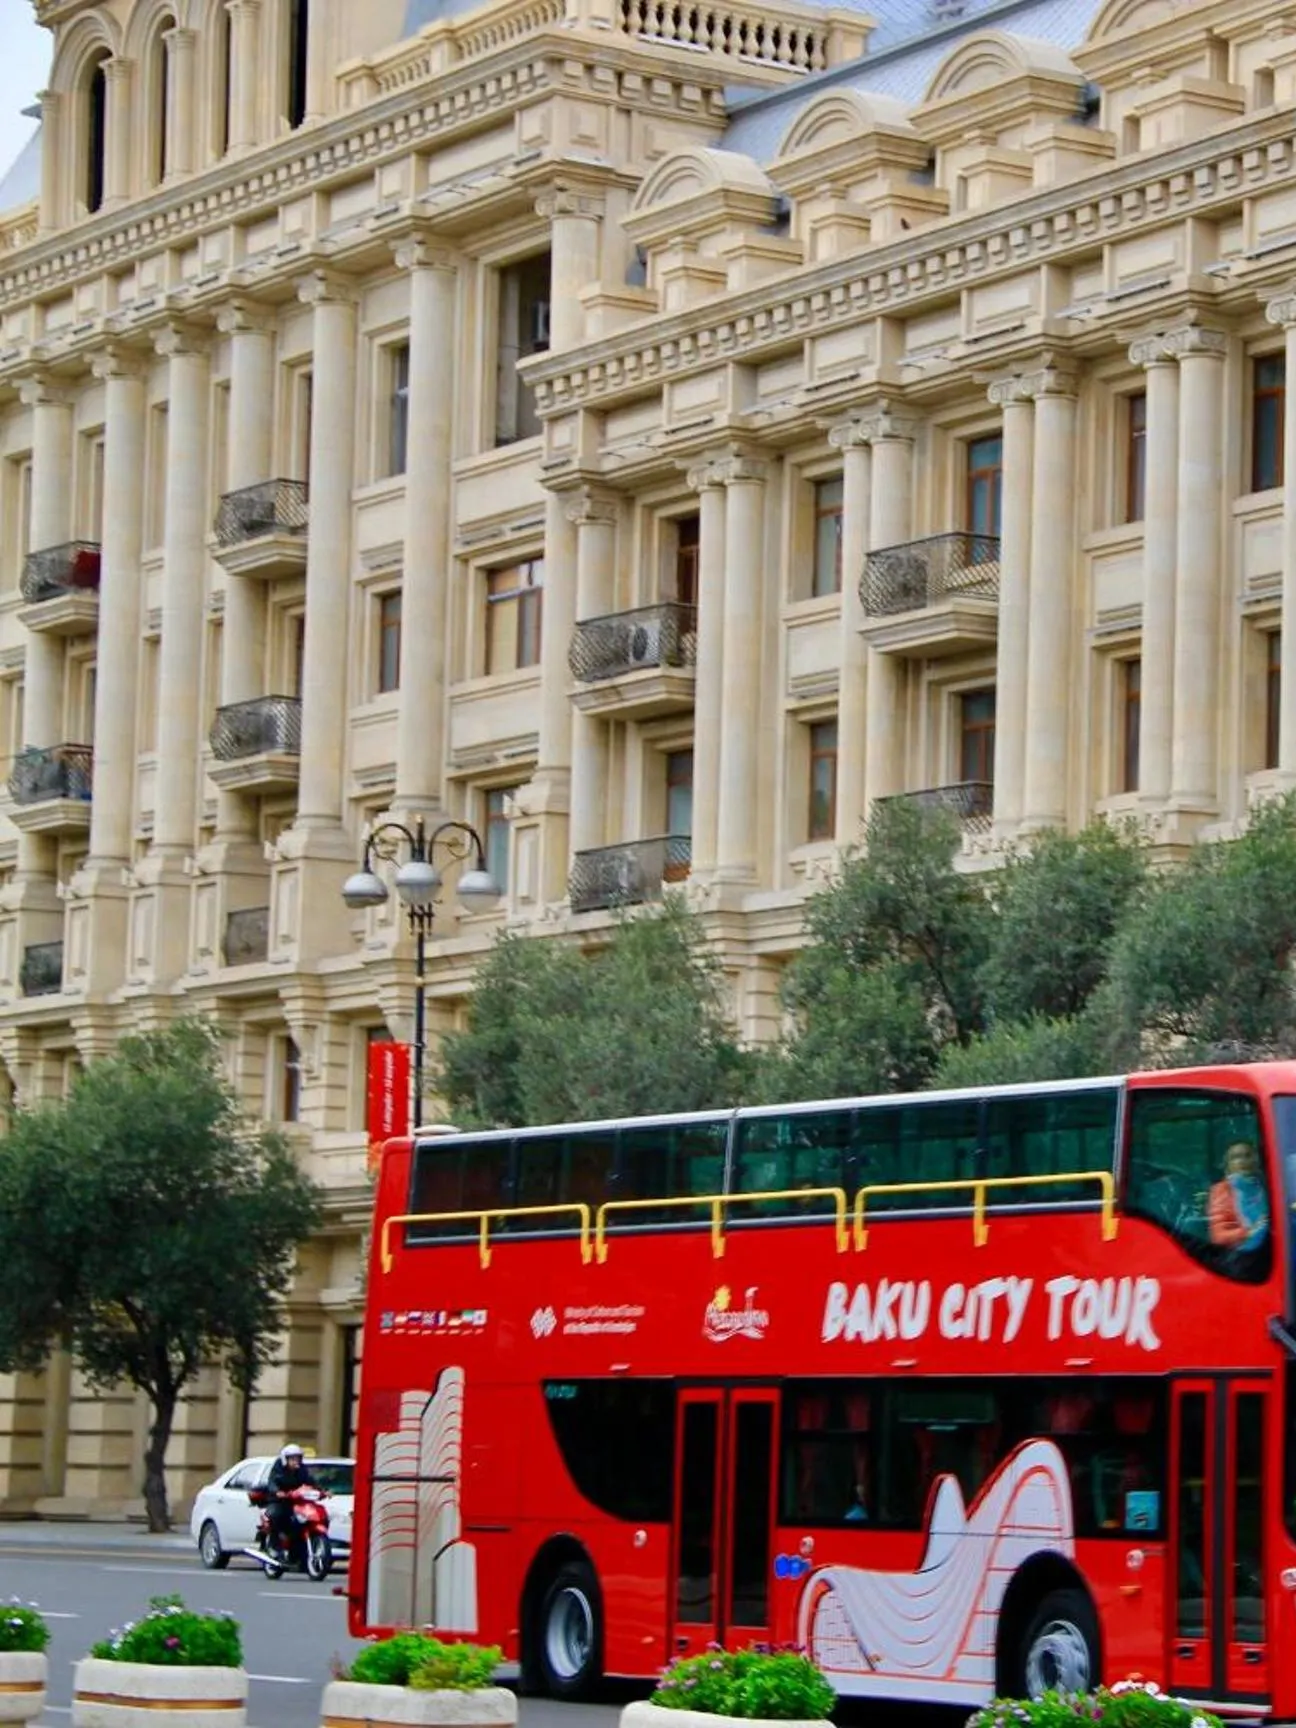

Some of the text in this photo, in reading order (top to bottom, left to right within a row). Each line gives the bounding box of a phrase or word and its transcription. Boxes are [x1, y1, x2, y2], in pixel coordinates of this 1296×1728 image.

[822, 1275, 1161, 1351] BAKU CITY TOUR
